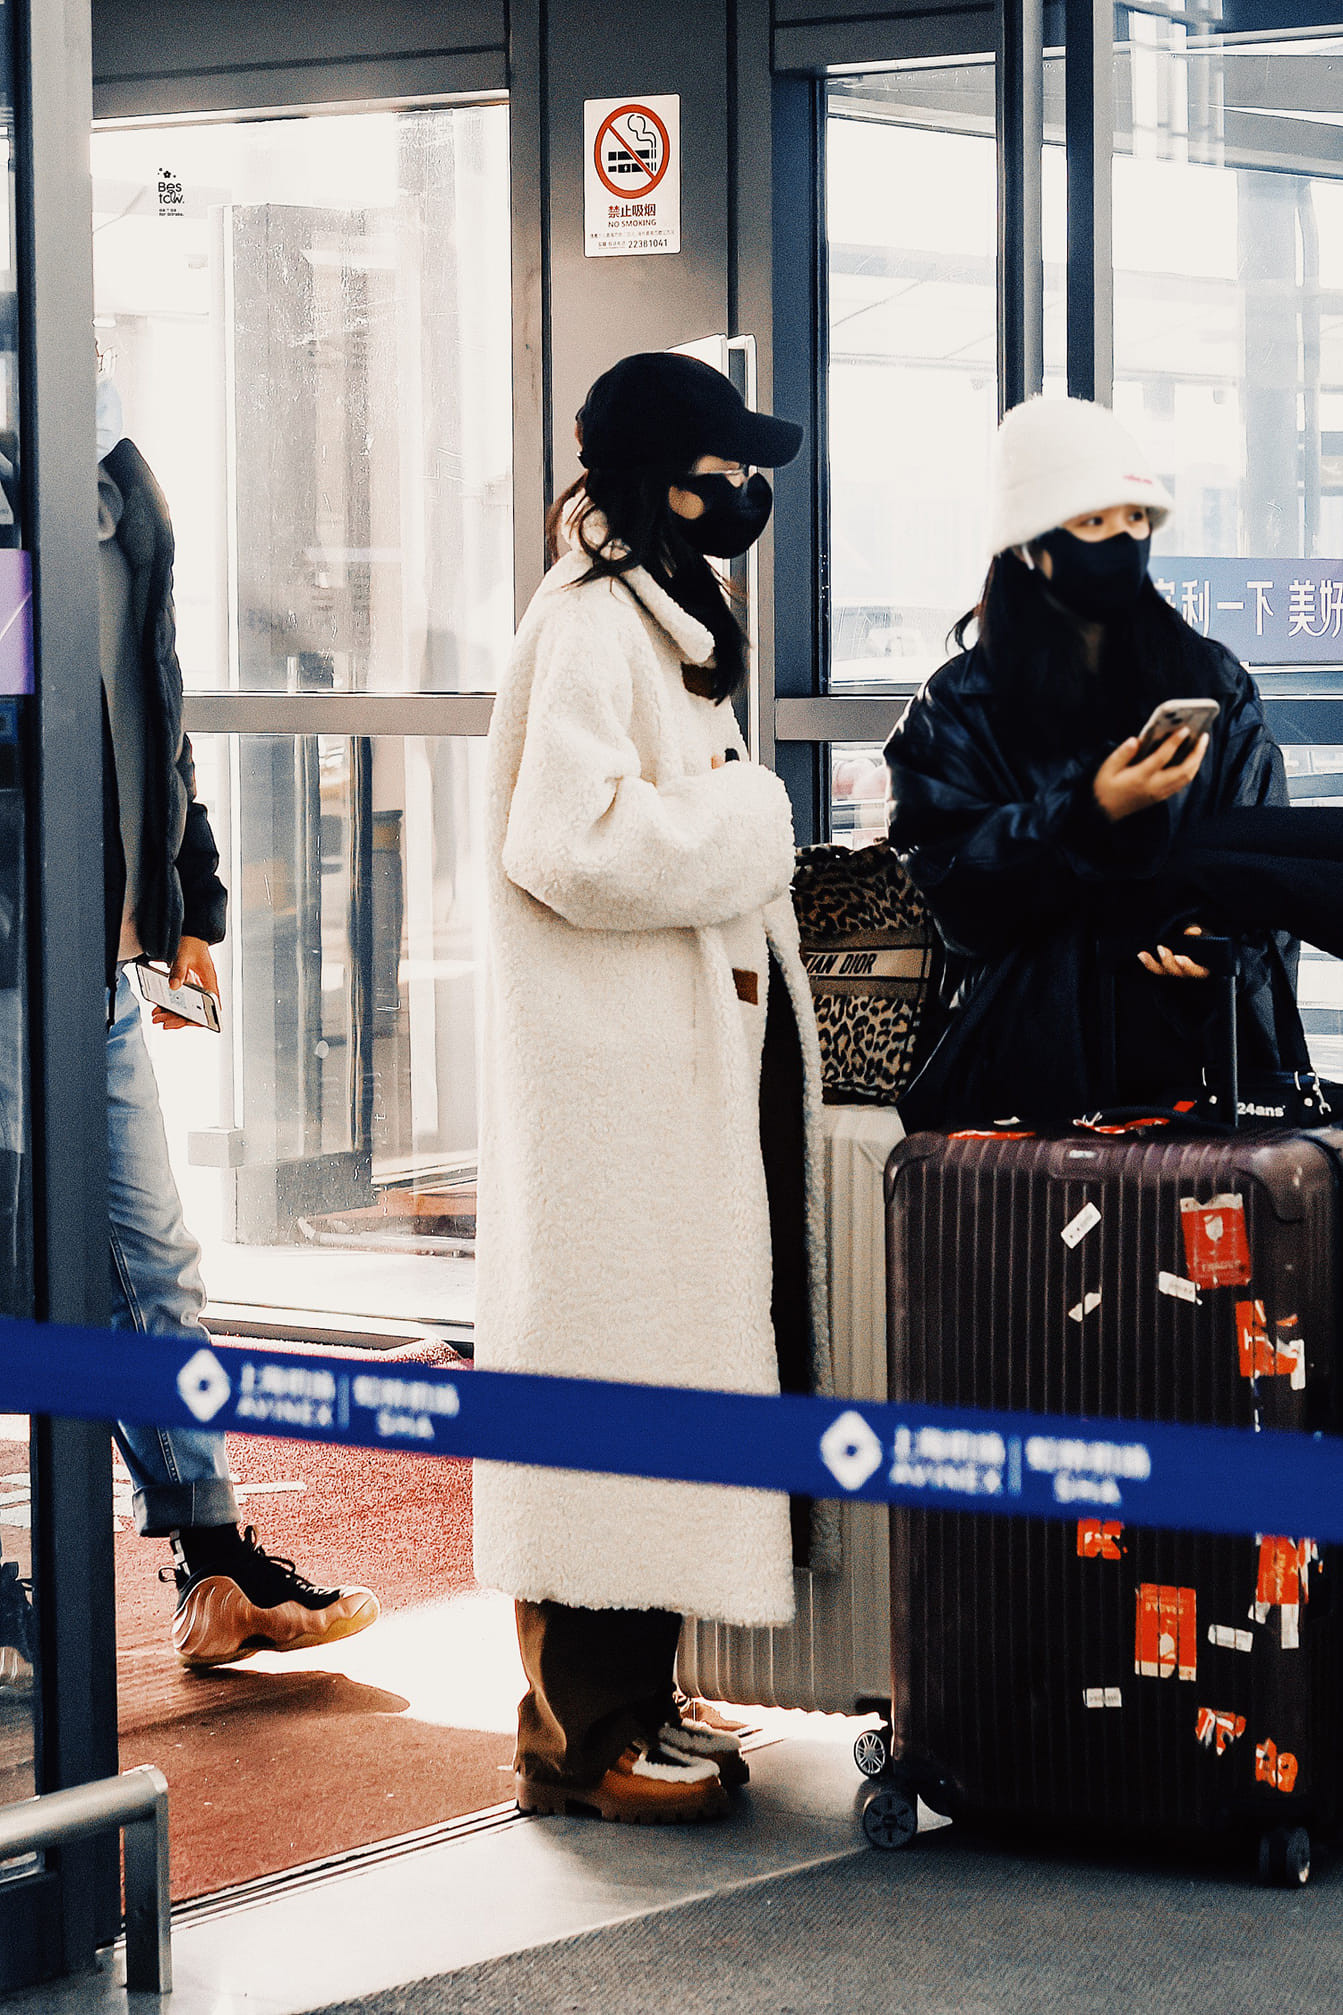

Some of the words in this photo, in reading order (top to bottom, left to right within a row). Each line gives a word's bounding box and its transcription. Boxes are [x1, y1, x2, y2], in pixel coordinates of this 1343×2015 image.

[158, 182, 182, 193] Bes
[608, 203, 657, 218] 禁止吸烟
[608, 220, 620, 228] NO
[621, 219, 657, 227] SMOKING
[628, 238, 668, 249] 22381041
[1287, 578, 1343, 638] 美好
[839, 953, 878, 974] DIOR
